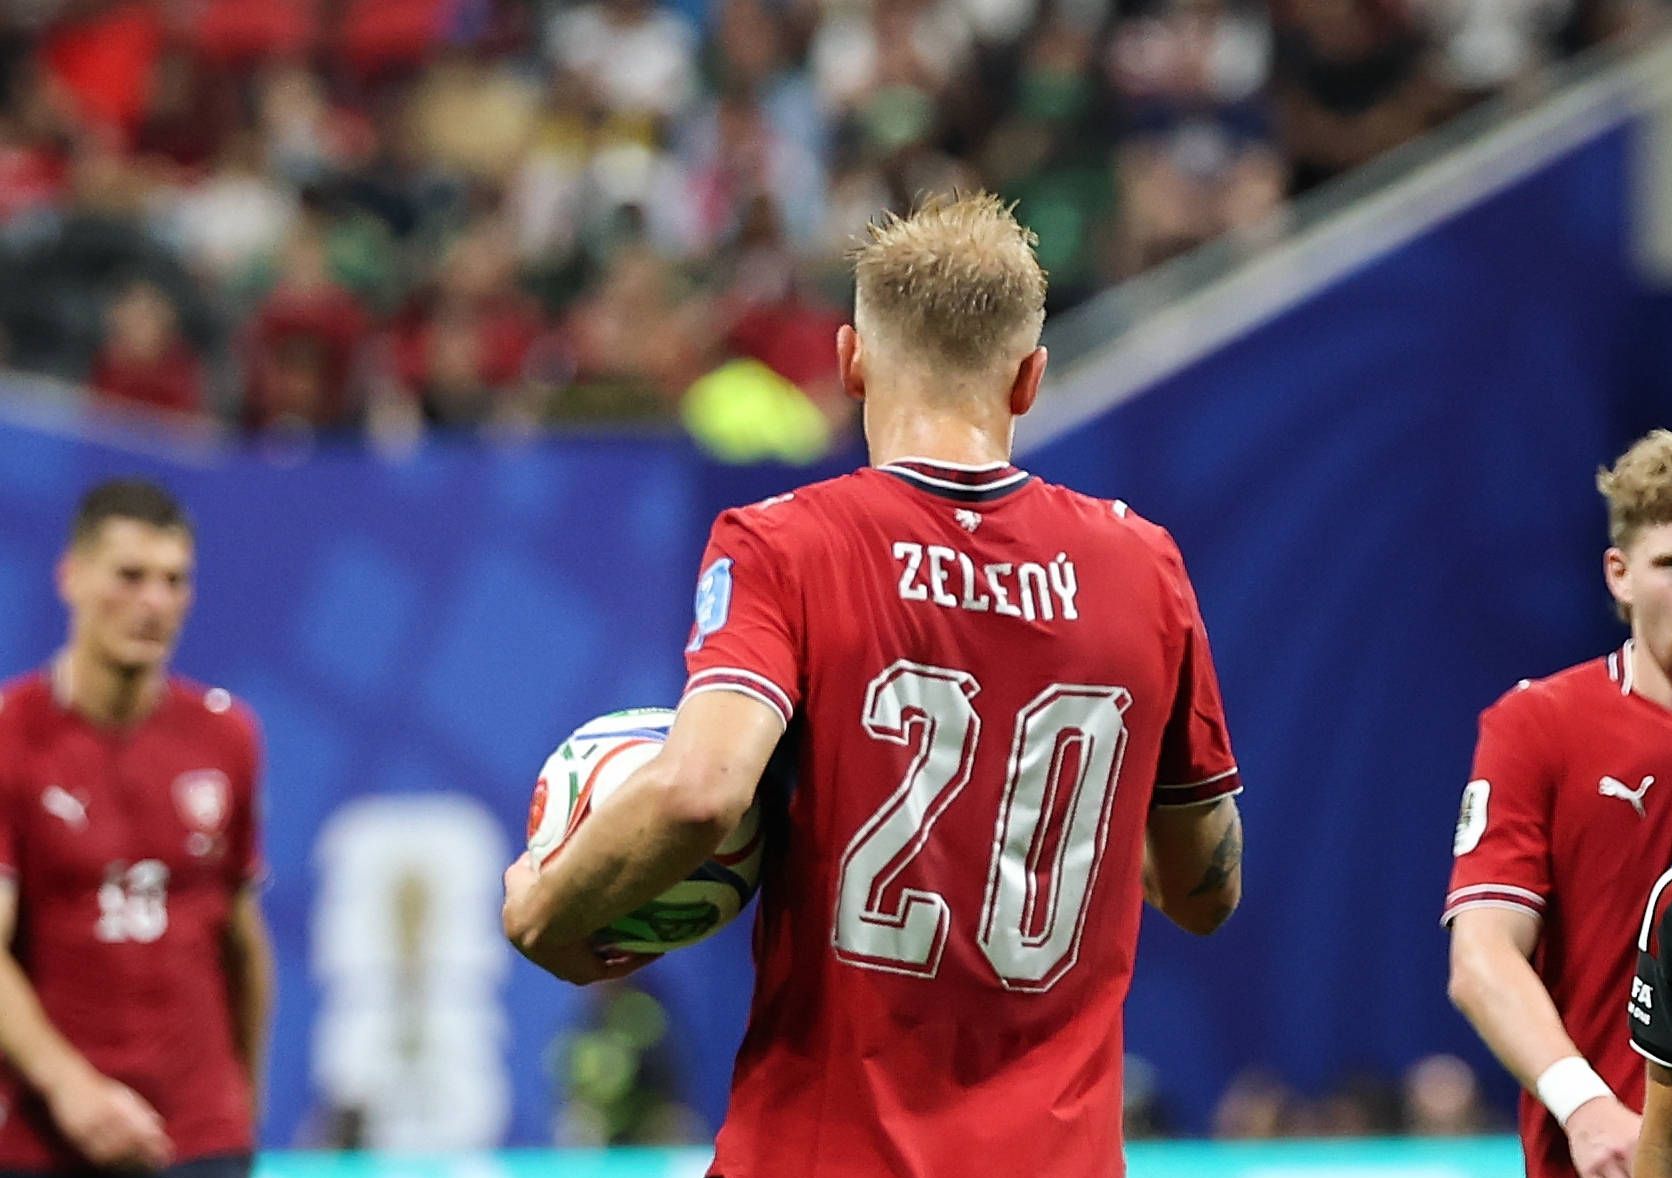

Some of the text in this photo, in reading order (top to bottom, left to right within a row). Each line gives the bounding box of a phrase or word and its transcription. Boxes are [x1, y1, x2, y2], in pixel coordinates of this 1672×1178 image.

[891, 540, 1079, 622] ZELENÝ
[832, 659, 1134, 993] 20
[1631, 975, 1652, 1009] FA
